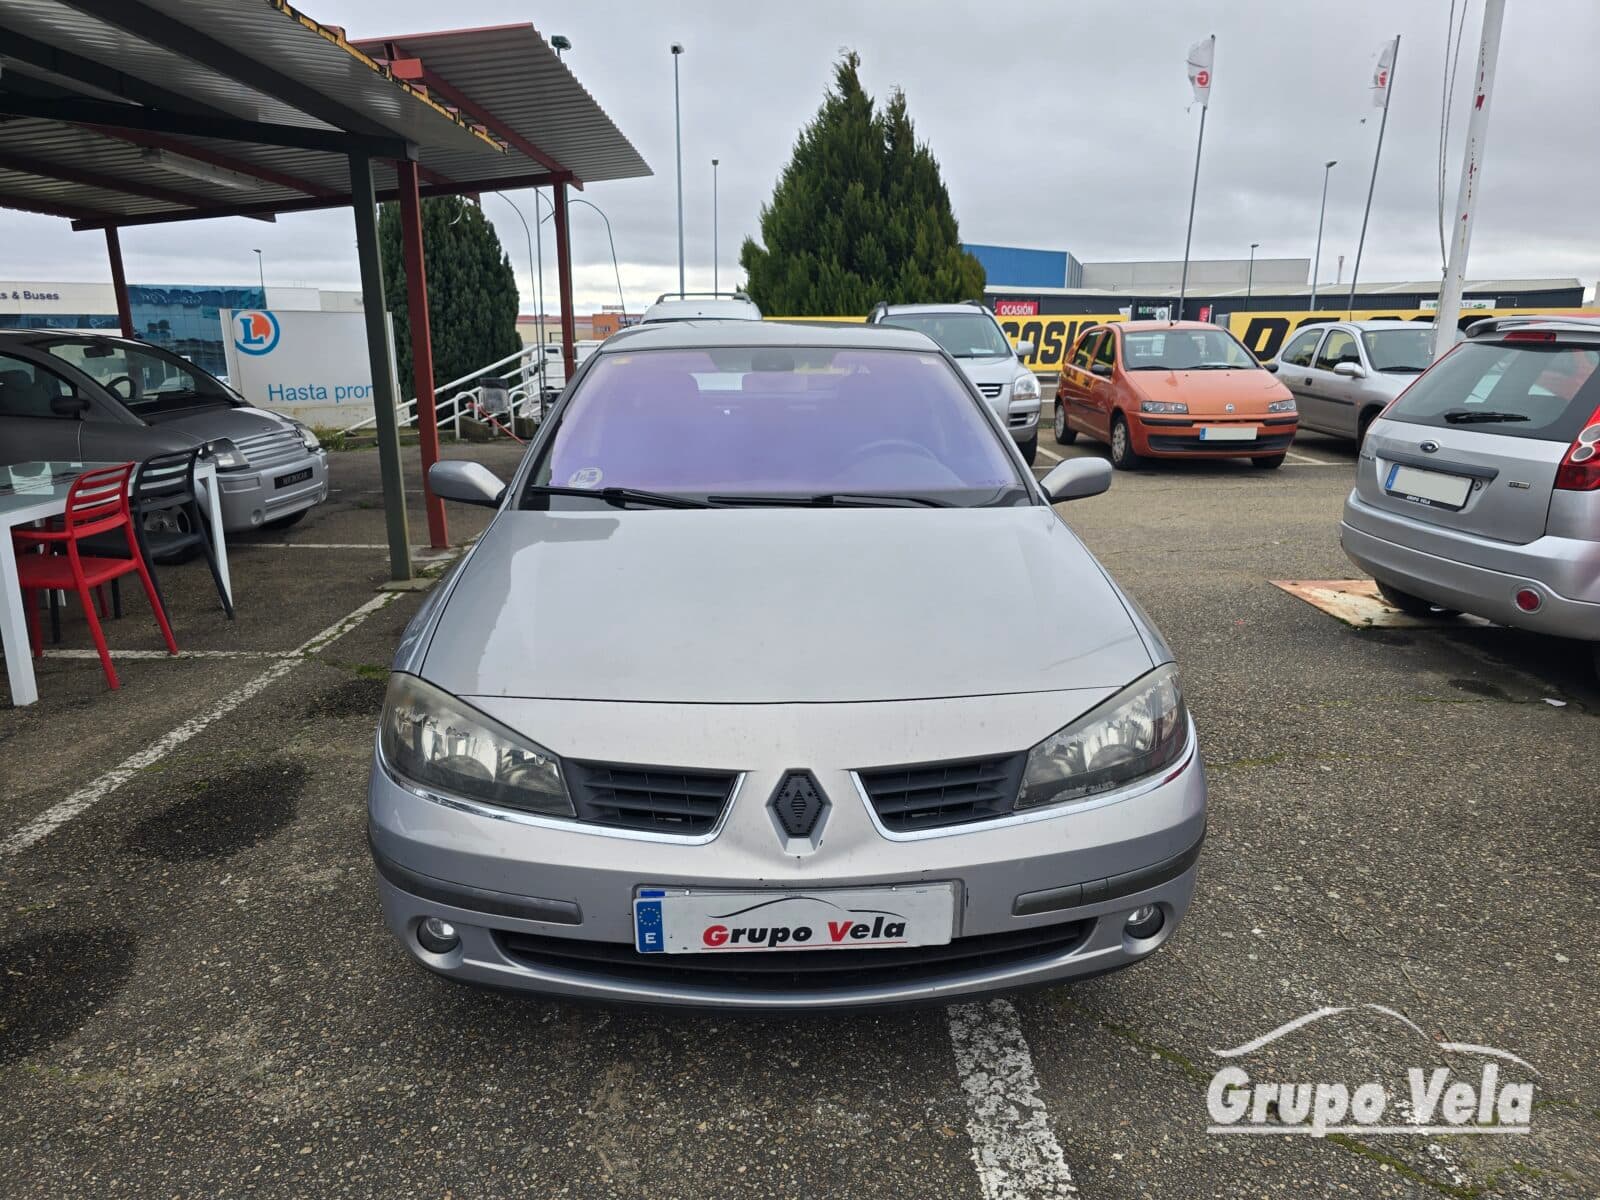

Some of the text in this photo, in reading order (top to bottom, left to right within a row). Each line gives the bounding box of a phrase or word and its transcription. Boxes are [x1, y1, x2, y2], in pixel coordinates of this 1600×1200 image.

[23, 290, 60, 301] Buses
[1001, 303, 1034, 315] OCASIÓN
[268, 384, 328, 401] Hasta
[645, 932, 656, 944] E
[703, 917, 906, 947] Grupo Vela
